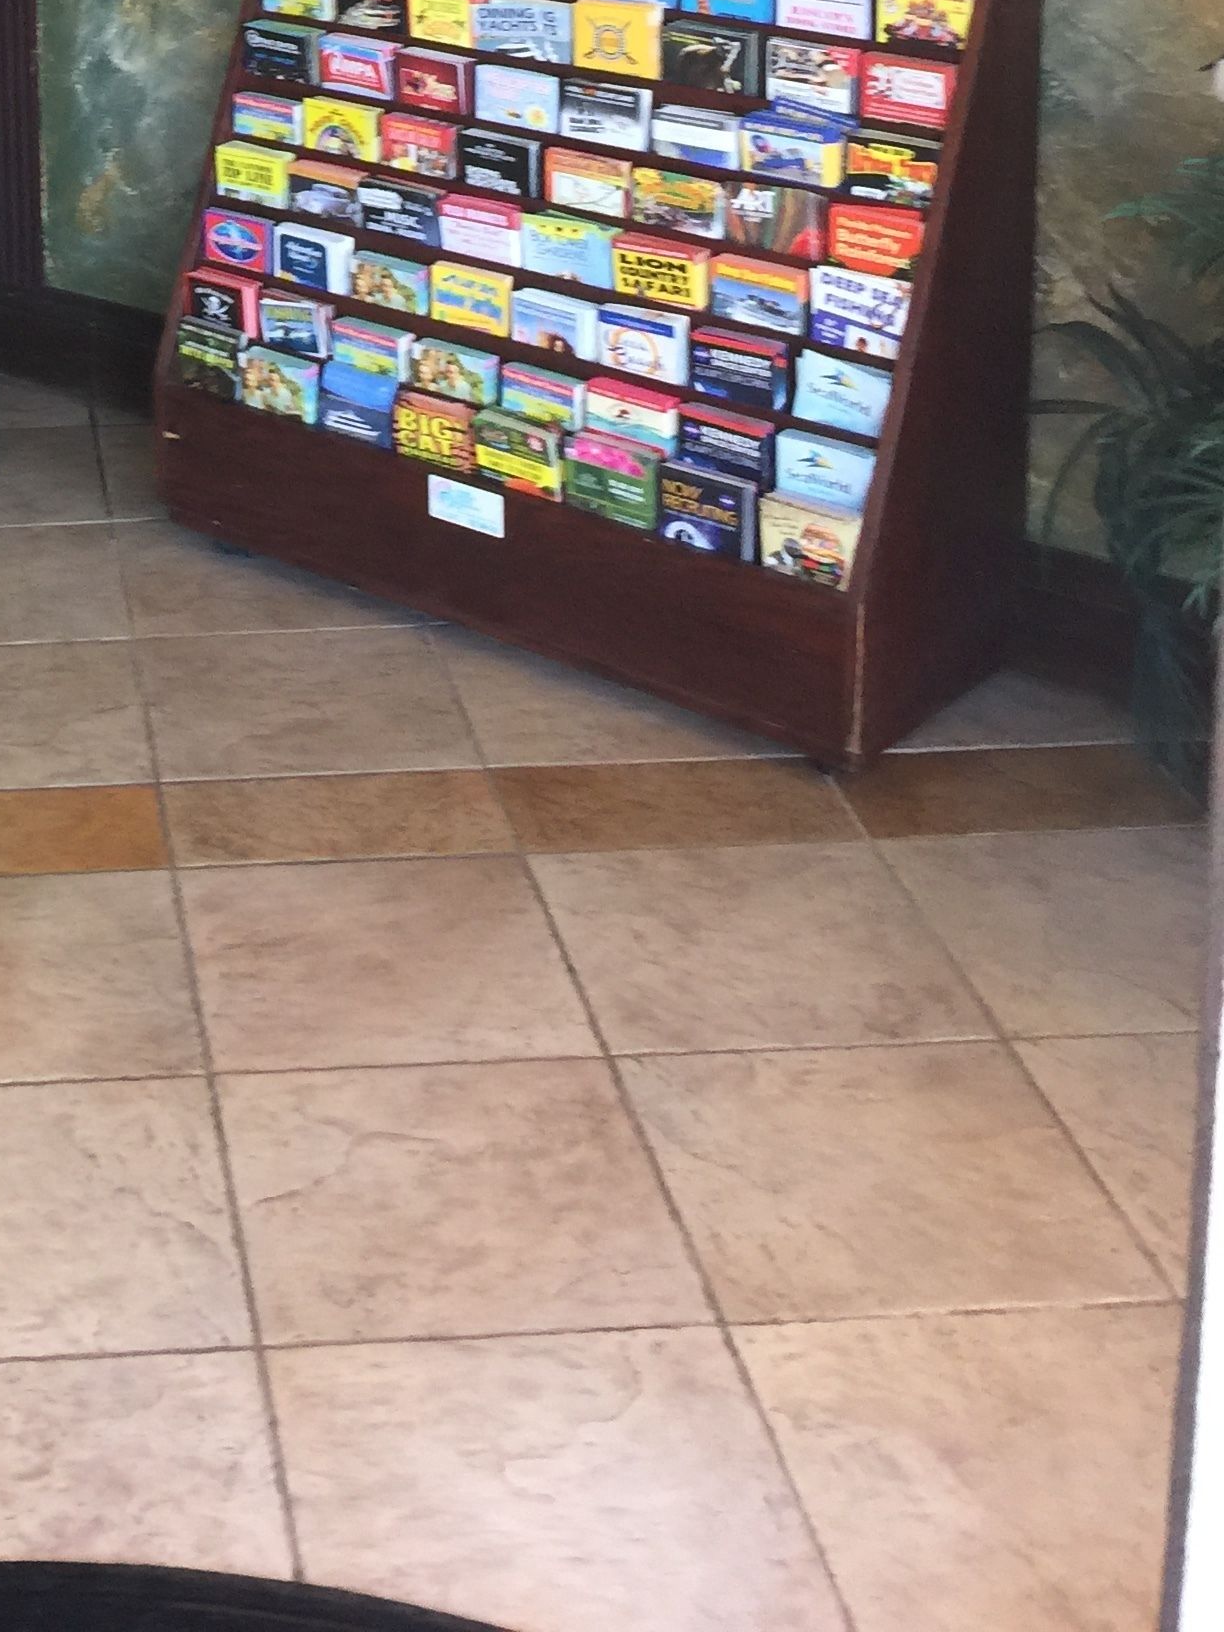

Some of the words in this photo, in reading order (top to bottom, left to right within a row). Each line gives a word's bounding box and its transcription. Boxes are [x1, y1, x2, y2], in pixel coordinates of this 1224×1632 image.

[478, 7, 535, 19] DINING
[479, 19, 538, 33] YACHTS
[619, 253, 688, 275] LION
[620, 265, 689, 286] COUNTRY
[622, 275, 691, 298] SAFARI
[821, 272, 865, 294] DEEP
[806, 381, 872, 416] SeaWorld
[397, 407, 452, 439] BIG
[397, 430, 454, 457] CAT
[662, 477, 705, 501] NOW
[786, 467, 853, 494] SeaWorld
